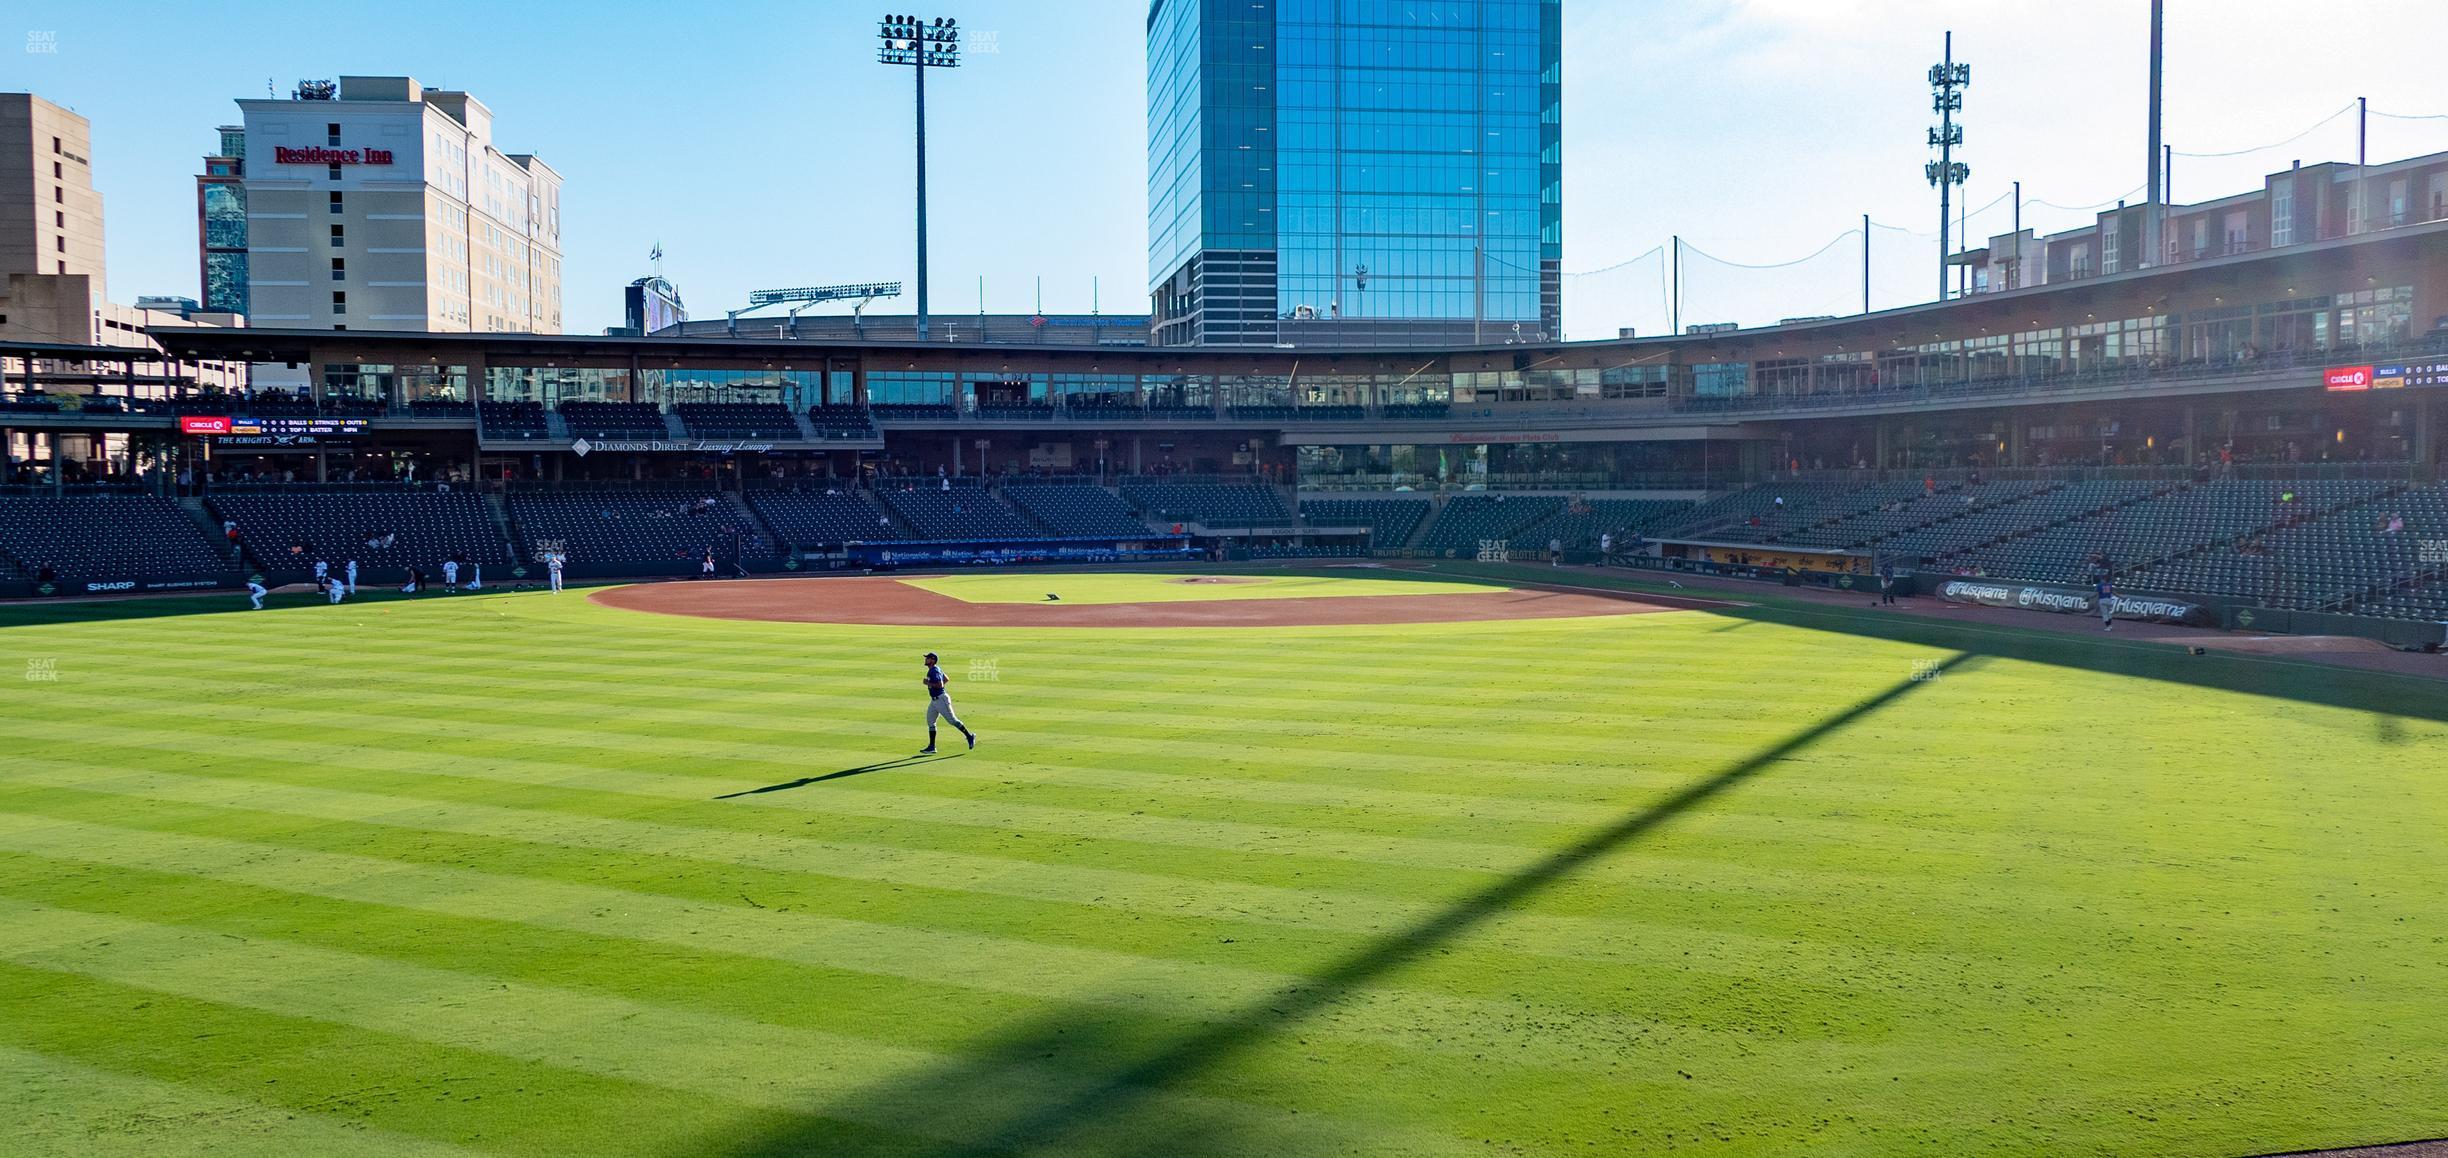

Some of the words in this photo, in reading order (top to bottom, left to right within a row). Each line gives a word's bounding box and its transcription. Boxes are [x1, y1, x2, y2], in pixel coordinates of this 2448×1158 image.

[275, 145, 359, 164] Residence
[364, 147, 393, 164] Inn
[218, 436, 234, 444] THE
[235, 436, 272, 444] KNIGHTS
[595, 441, 648, 452] DIAMONDS
[652, 441, 688, 451] DIRECT
[693, 440, 733, 454] Luxury
[733, 440, 774, 454] Lounge
[87, 581, 135, 591] SHARP
[1956, 581, 2008, 600] Husqvarna
[2031, 589, 2089, 609] Husqvarna
[2116, 597, 2187, 616] Husqvarna
